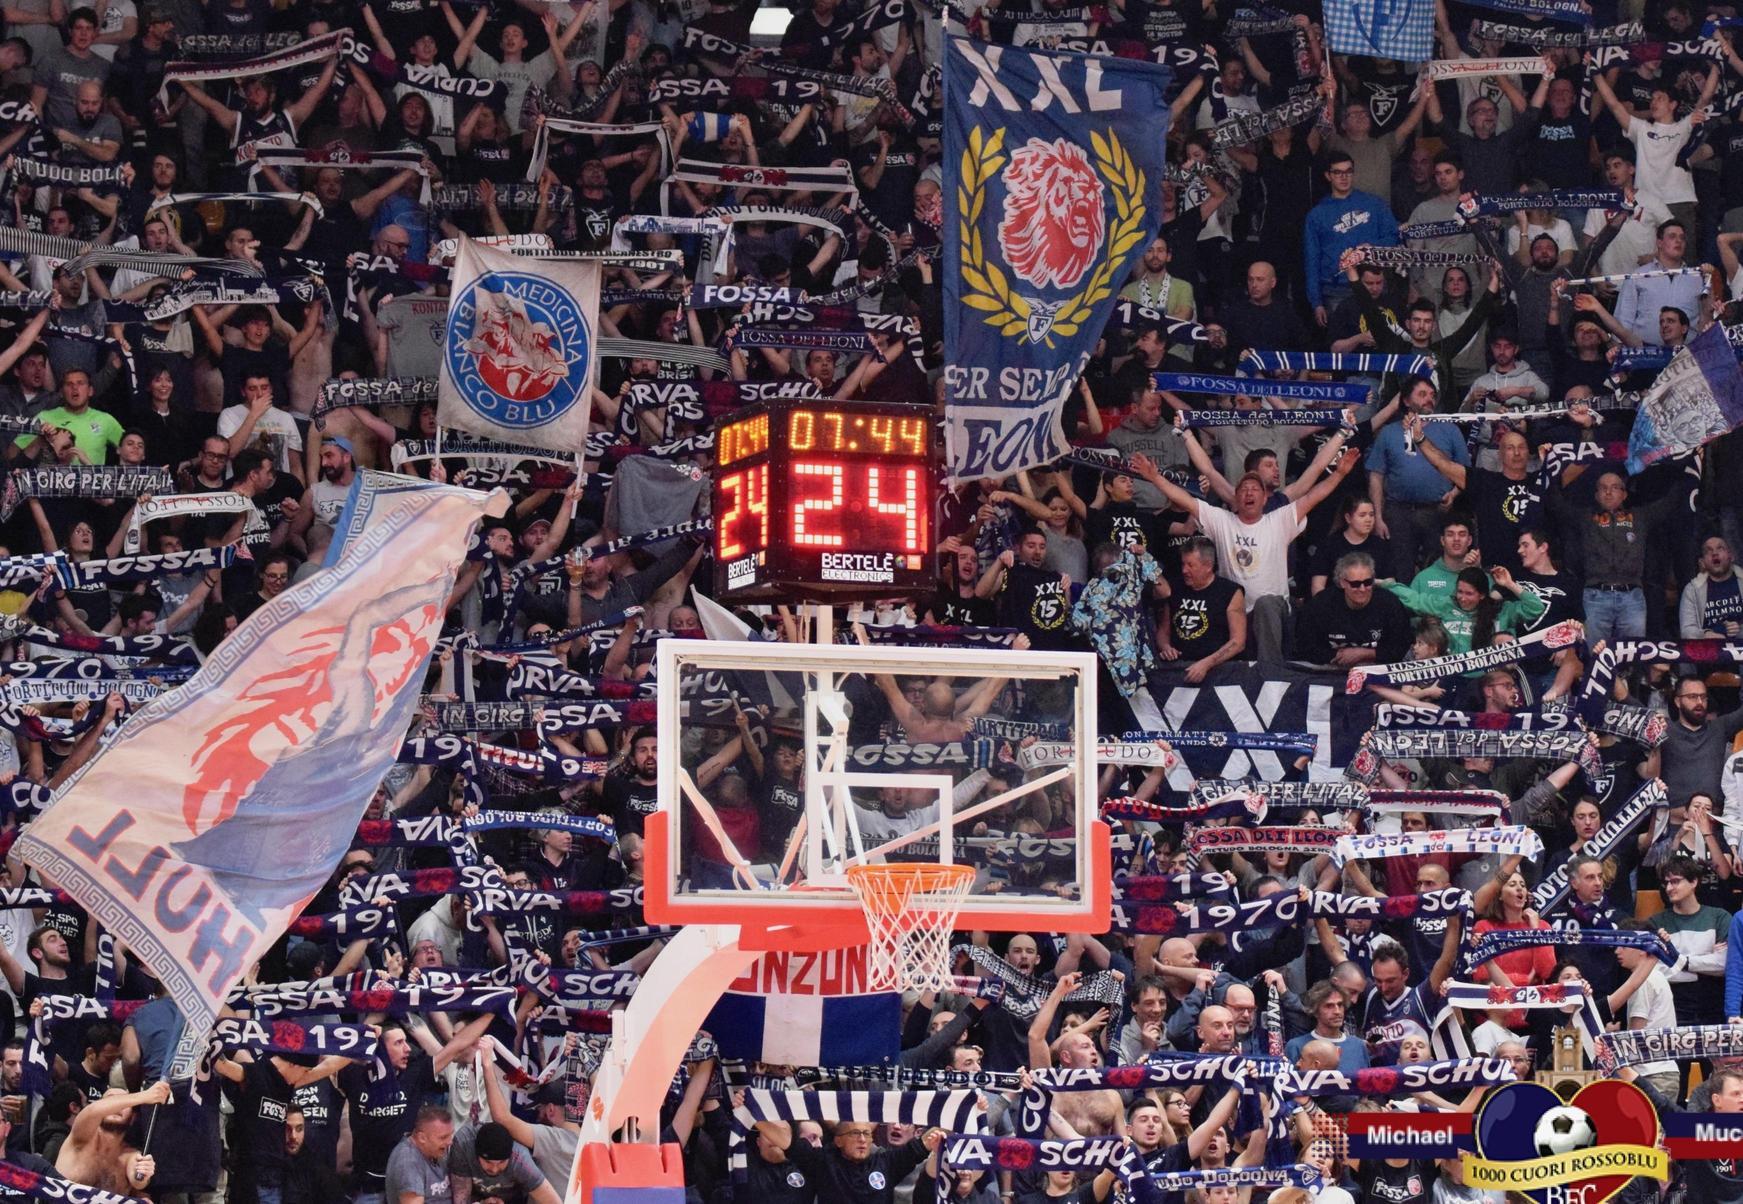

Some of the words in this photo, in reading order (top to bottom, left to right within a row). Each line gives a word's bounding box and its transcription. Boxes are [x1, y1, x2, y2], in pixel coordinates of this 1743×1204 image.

[954, 39, 1122, 114] XXL
[704, 285, 791, 304] FOSSA
[503, 279, 583, 366] MEDICINA
[1190, 376, 1247, 395] FOSSA
[1278, 385, 1332, 399] LEONI
[503, 398, 557, 422] BLU
[1190, 410, 1241, 421] FOSSA
[1283, 410, 1335, 420] LEONI
[790, 412, 924, 454] 07:44
[37, 472, 77, 491] GIRO
[82, 474, 112, 492] PER
[794, 463, 918, 550] 24
[1112, 516, 1141, 529] XXL
[81, 548, 216, 581] FOSSA
[1035, 582, 1064, 596] XXL
[1039, 600, 1060, 619] 15
[1178, 599, 1208, 612] XXL
[1179, 615, 1200, 630] 15
[1389, 661, 1464, 684] FORTITUDO
[1464, 646, 1526, 674] BOLOGNA
[474, 703, 525, 723] GIRO
[1262, 783, 1295, 801] PER
[1613, 1037, 1639, 1058] IN
[1645, 1032, 1697, 1054] GIRO
